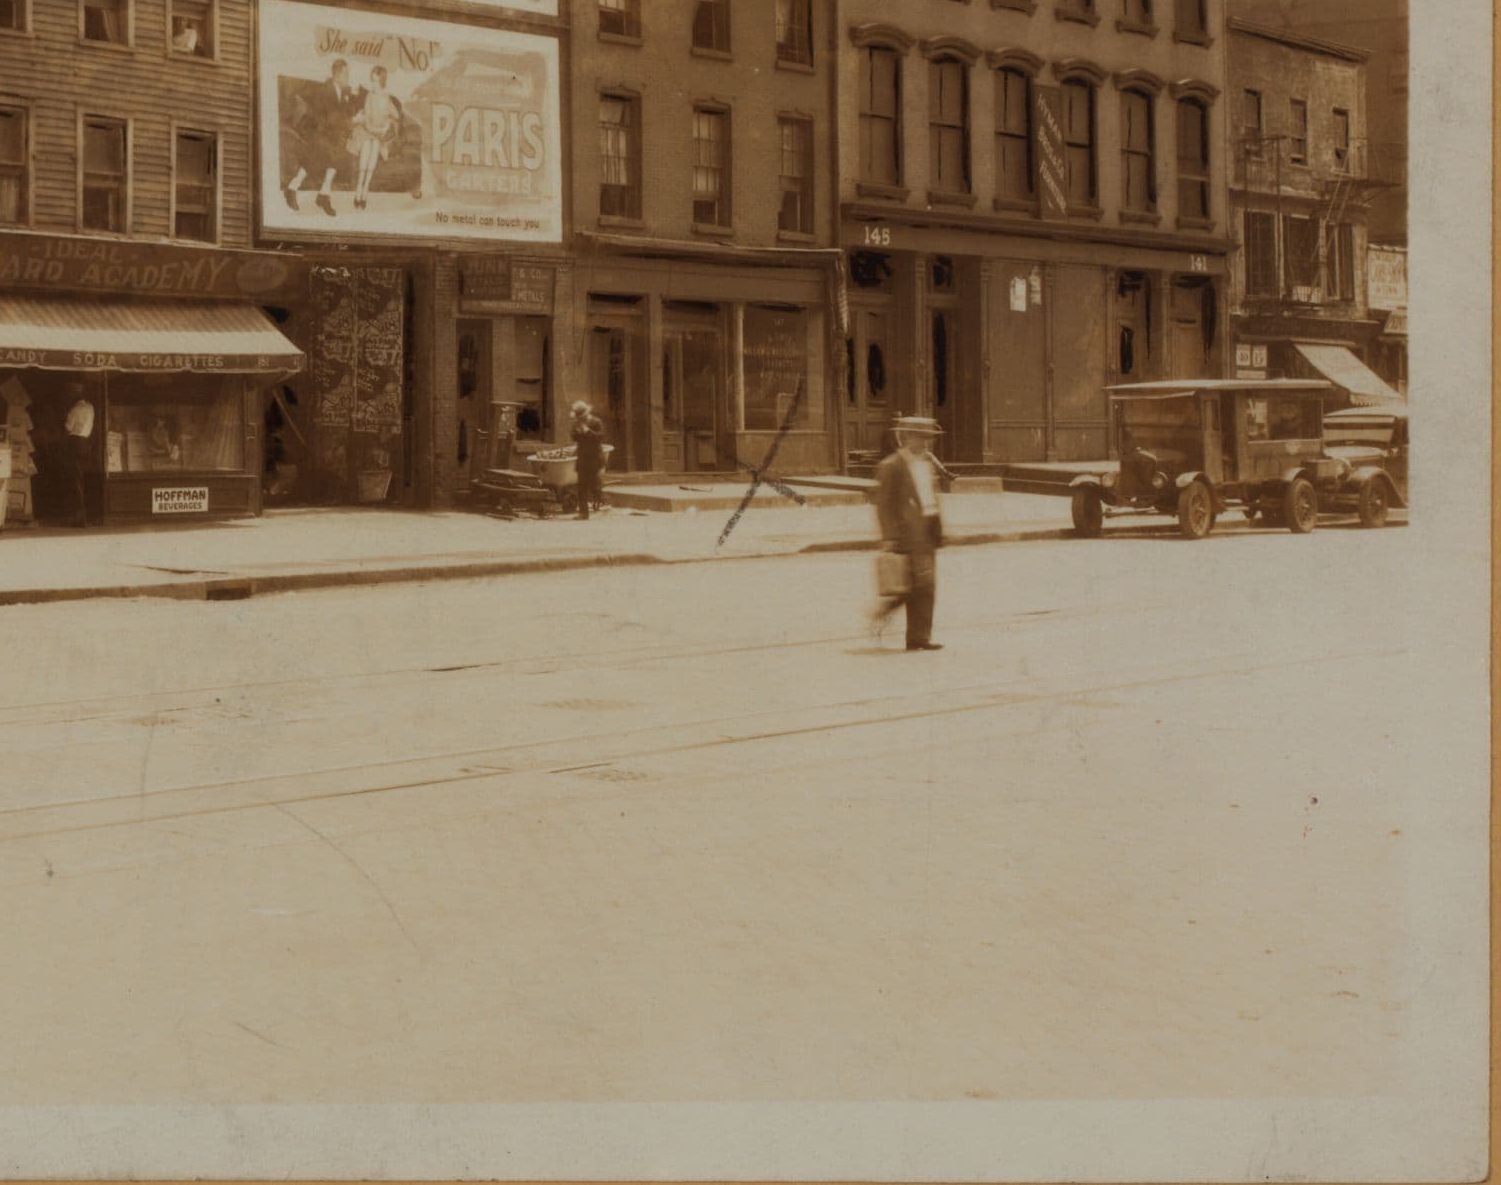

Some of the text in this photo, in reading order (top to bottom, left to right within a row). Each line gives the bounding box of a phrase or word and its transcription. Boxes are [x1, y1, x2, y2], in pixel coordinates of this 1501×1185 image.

[319, 28, 347, 54] She
[352, 37, 384, 58] said
[429, 101, 546, 171] PARIS
[436, 211, 540, 230] No metal can touch you
[864, 225, 890, 246] 145
[44, 241, 125, 263] IDEAL
[1190, 254, 1207, 271] 141
[81, 257, 231, 292] ACADEMY
[73, 352, 117, 367] SODA
[140, 355, 224, 368] CIGARETTES
[155, 490, 206, 502] HOFFMAN
[158, 502, 202, 511] BEVERAGES
